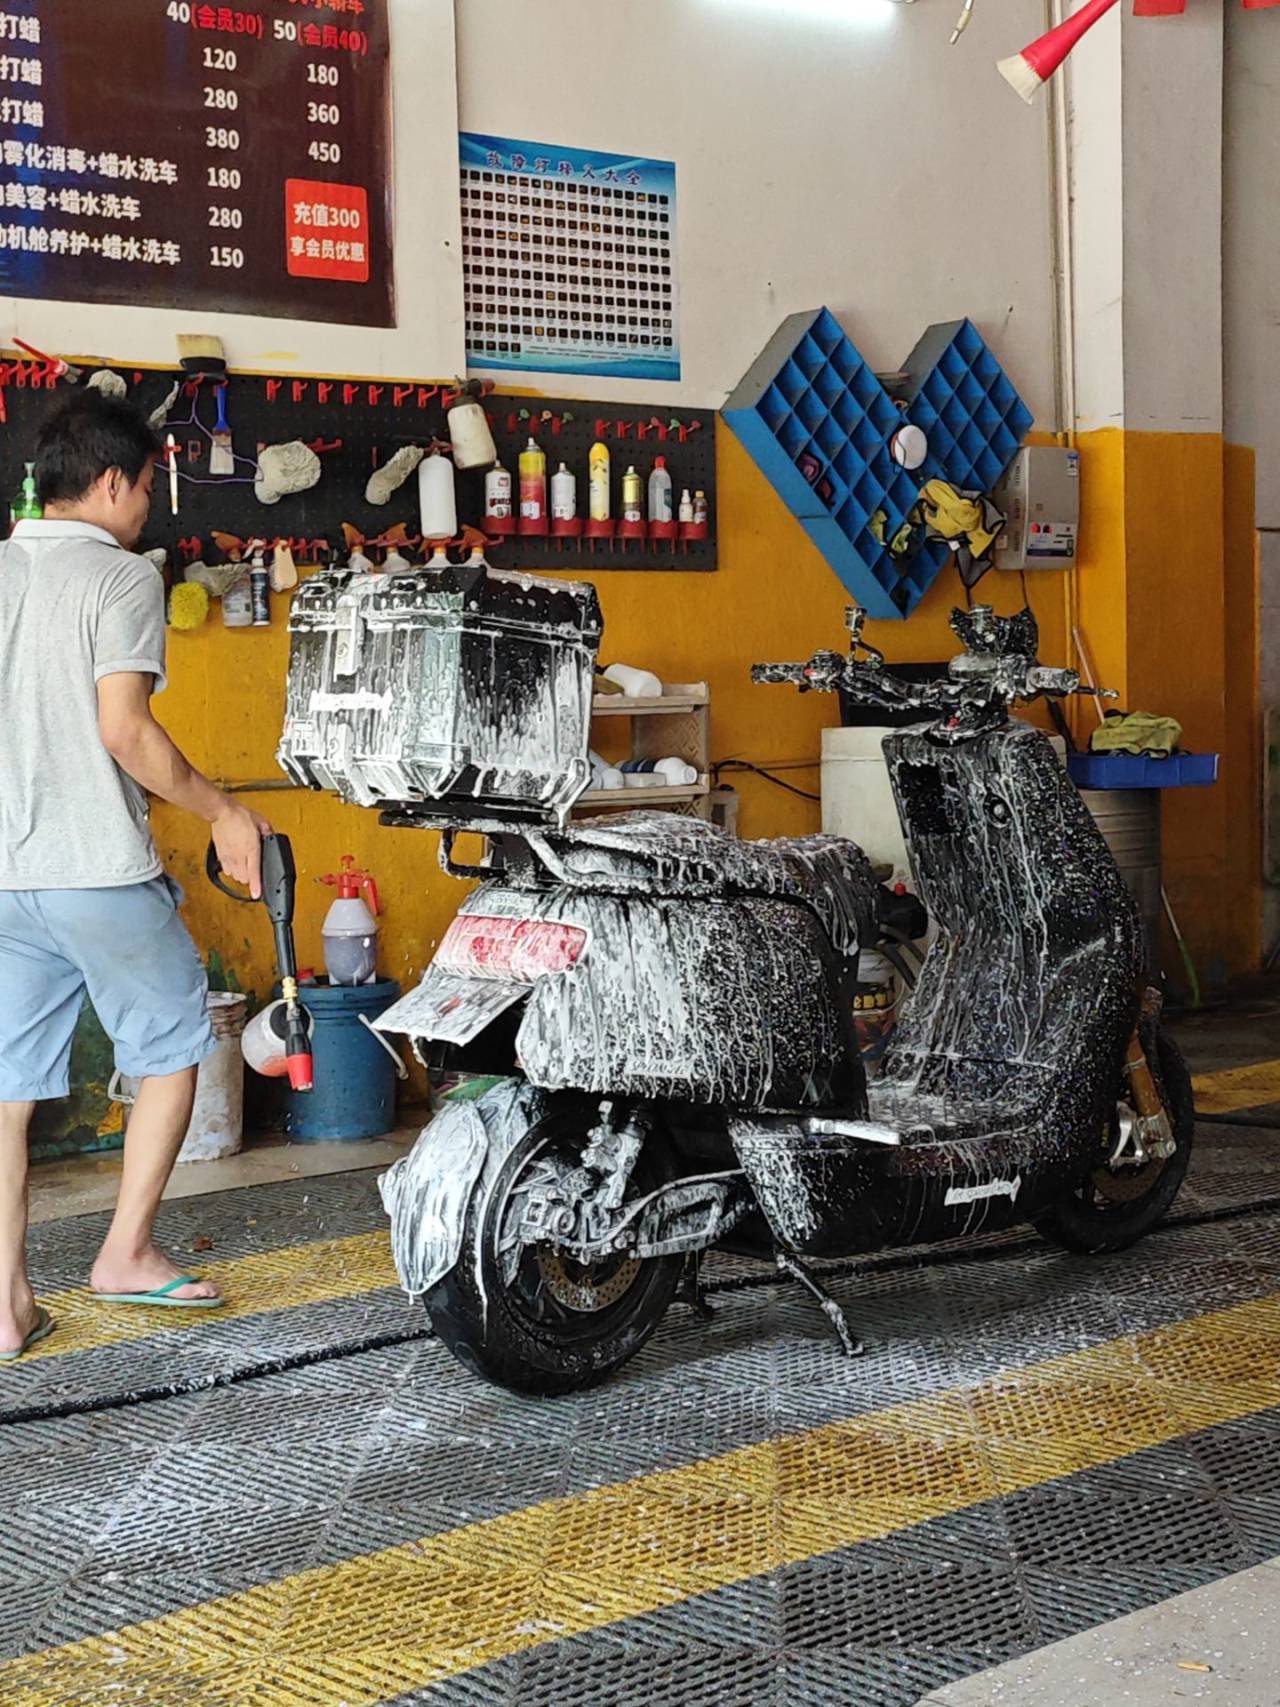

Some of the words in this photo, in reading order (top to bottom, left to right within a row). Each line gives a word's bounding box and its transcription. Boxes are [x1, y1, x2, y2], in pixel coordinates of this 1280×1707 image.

[166, 1, 264, 40] 40(会员30)
[273, 19, 368, 56] 50(会员40)
[203, 47, 237, 71] 120
[307, 63, 339, 86] 180
[203, 86, 238, 111] 280
[307, 101, 340, 125] 360
[205, 126, 240, 150] 380
[0, 140, 179, 185] 雾化消毒+蜡水洗车
[308, 141, 341, 163] 450
[207, 167, 241, 190] 180
[0, 182, 141, 221] 美容+蜡水洗车
[208, 206, 242, 229] 280
[293, 201, 360, 229] 充值300
[210, 246, 244, 268] 150
[290, 235, 365, 262] 享会员优惠
